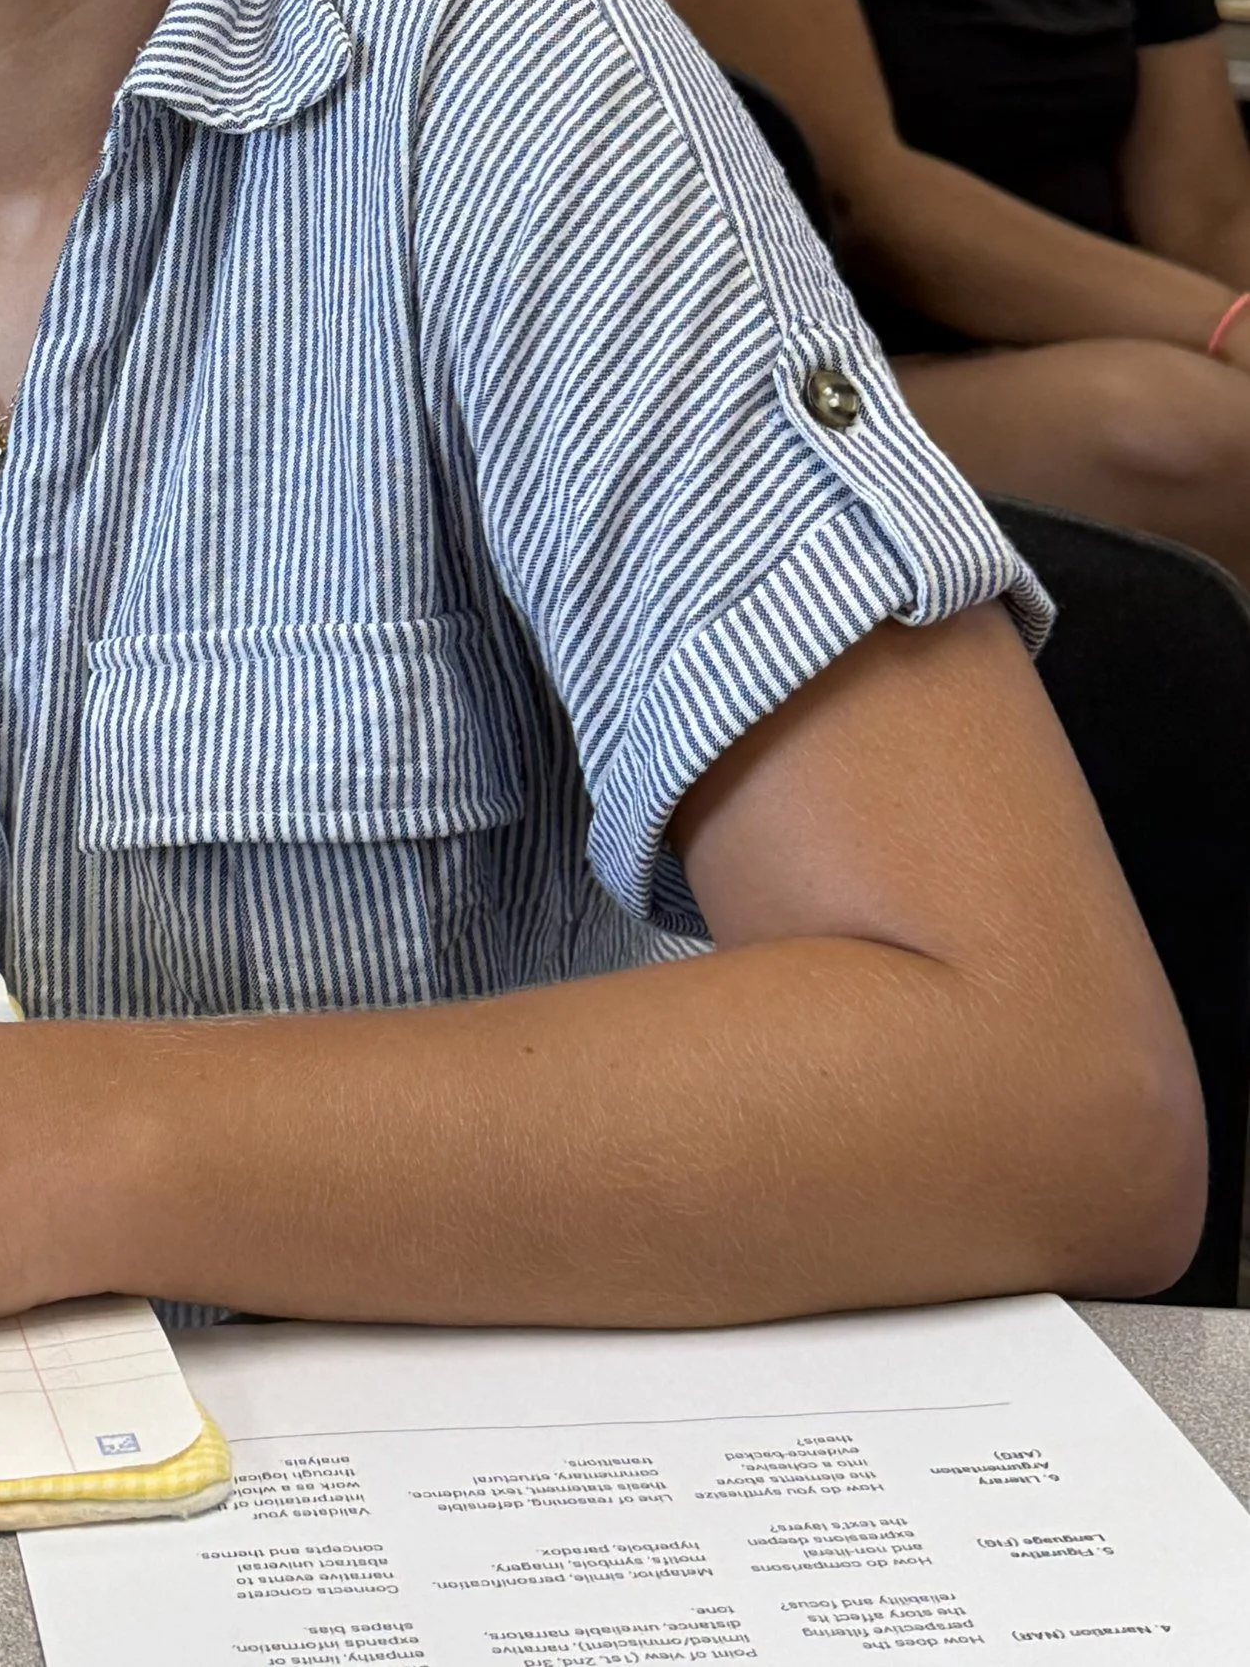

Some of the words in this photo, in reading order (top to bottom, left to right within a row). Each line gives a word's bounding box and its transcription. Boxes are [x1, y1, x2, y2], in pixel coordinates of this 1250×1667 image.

[796, 1434, 853, 1447] thesis?
[724, 1446, 860, 1462] evidence-backed
[993, 1448, 1042, 1461] (ARG)
[836, 1458, 868, 1468] into
[929, 1461, 1049, 1475] Argumentation
[233, 1471, 288, 1485] logical
[292, 1468, 356, 1480] through
[472, 1473, 551, 1486] structural
[769, 1473, 845, 1484] elements
[849, 1470, 877, 1480] the
[1043, 1473, 1060, 1482] 6.
[716, 1476, 765, 1485] above
[978, 1475, 1041, 1485] Literary
[281, 1484, 291, 1492] a
[296, 1483, 315, 1491] as
[319, 1481, 361, 1491] work
[616, 1481, 667, 1492] thesis
[786, 1485, 817, 1495] you
[820, 1485, 842, 1495] do
[846, 1483, 885, 1492] How
[490, 1487, 523, 1497] text
[694, 1487, 782, 1499] synthesize
[253, 1493, 365, 1507] interpretation
[618, 1495, 635, 1505] of
[638, 1493, 674, 1503] Line
[233, 1500, 249, 1511] of
[437, 1500, 524, 1513] defensible
[253, 1508, 289, 1520] your
[292, 1507, 372, 1518] Validates
[770, 1521, 828, 1534] layers?
[879, 1517, 908, 1527] the
[747, 1536, 810, 1546] deepen
[813, 1530, 915, 1544] expressions
[976, 1536, 1020, 1549] (FIG)
[1022, 1533, 1106, 1545] Language
[269, 1547, 300, 1558] and
[305, 1543, 384, 1555] concepts
[803, 1545, 888, 1559] non-literal
[890, 1543, 923, 1554] and
[1010, 1547, 1095, 1560] Figurative
[1096, 1546, 1115, 1556] 5.
[237, 1560, 314, 1573] universal
[318, 1558, 388, 1568] abstract
[750, 1560, 863, 1572] comparisons
[866, 1559, 888, 1568] do
[893, 1556, 933, 1566] How
[236, 1576, 254, 1586] to
[257, 1573, 314, 1584] events
[319, 1571, 394, 1583] narrative
[237, 1587, 312, 1600] concrete
[316, 1584, 399, 1595] Connects
[840, 1598, 874, 1609] and
[879, 1593, 957, 1606] reliability
[780, 1599, 838, 1612] focus?
[936, 1606, 967, 1616] the
[807, 1614, 830, 1624] its
[832, 1612, 885, 1623] affect
[890, 1608, 934, 1619] story
[350, 1622, 414, 1633] shapes
[574, 1624, 660, 1638] unreliable
[873, 1618, 975, 1635] perspective
[1069, 1625, 1153, 1637] Narration
[1154, 1624, 1171, 1633] 4.
[801, 1627, 870, 1638] filtering
[1011, 1628, 1066, 1642] (NAR)
[344, 1635, 420, 1649] expands
[862, 1640, 892, 1650] the
[894, 1637, 939, 1648] does
[943, 1634, 986, 1645] How
[491, 1643, 570, 1655] narrative
[711, 1648, 758, 1659] Point
[268, 1657, 287, 1666] or
[291, 1655, 341, 1665] limits
[645, 1652, 685, 1661] view
[689, 1650, 707, 1662] of
